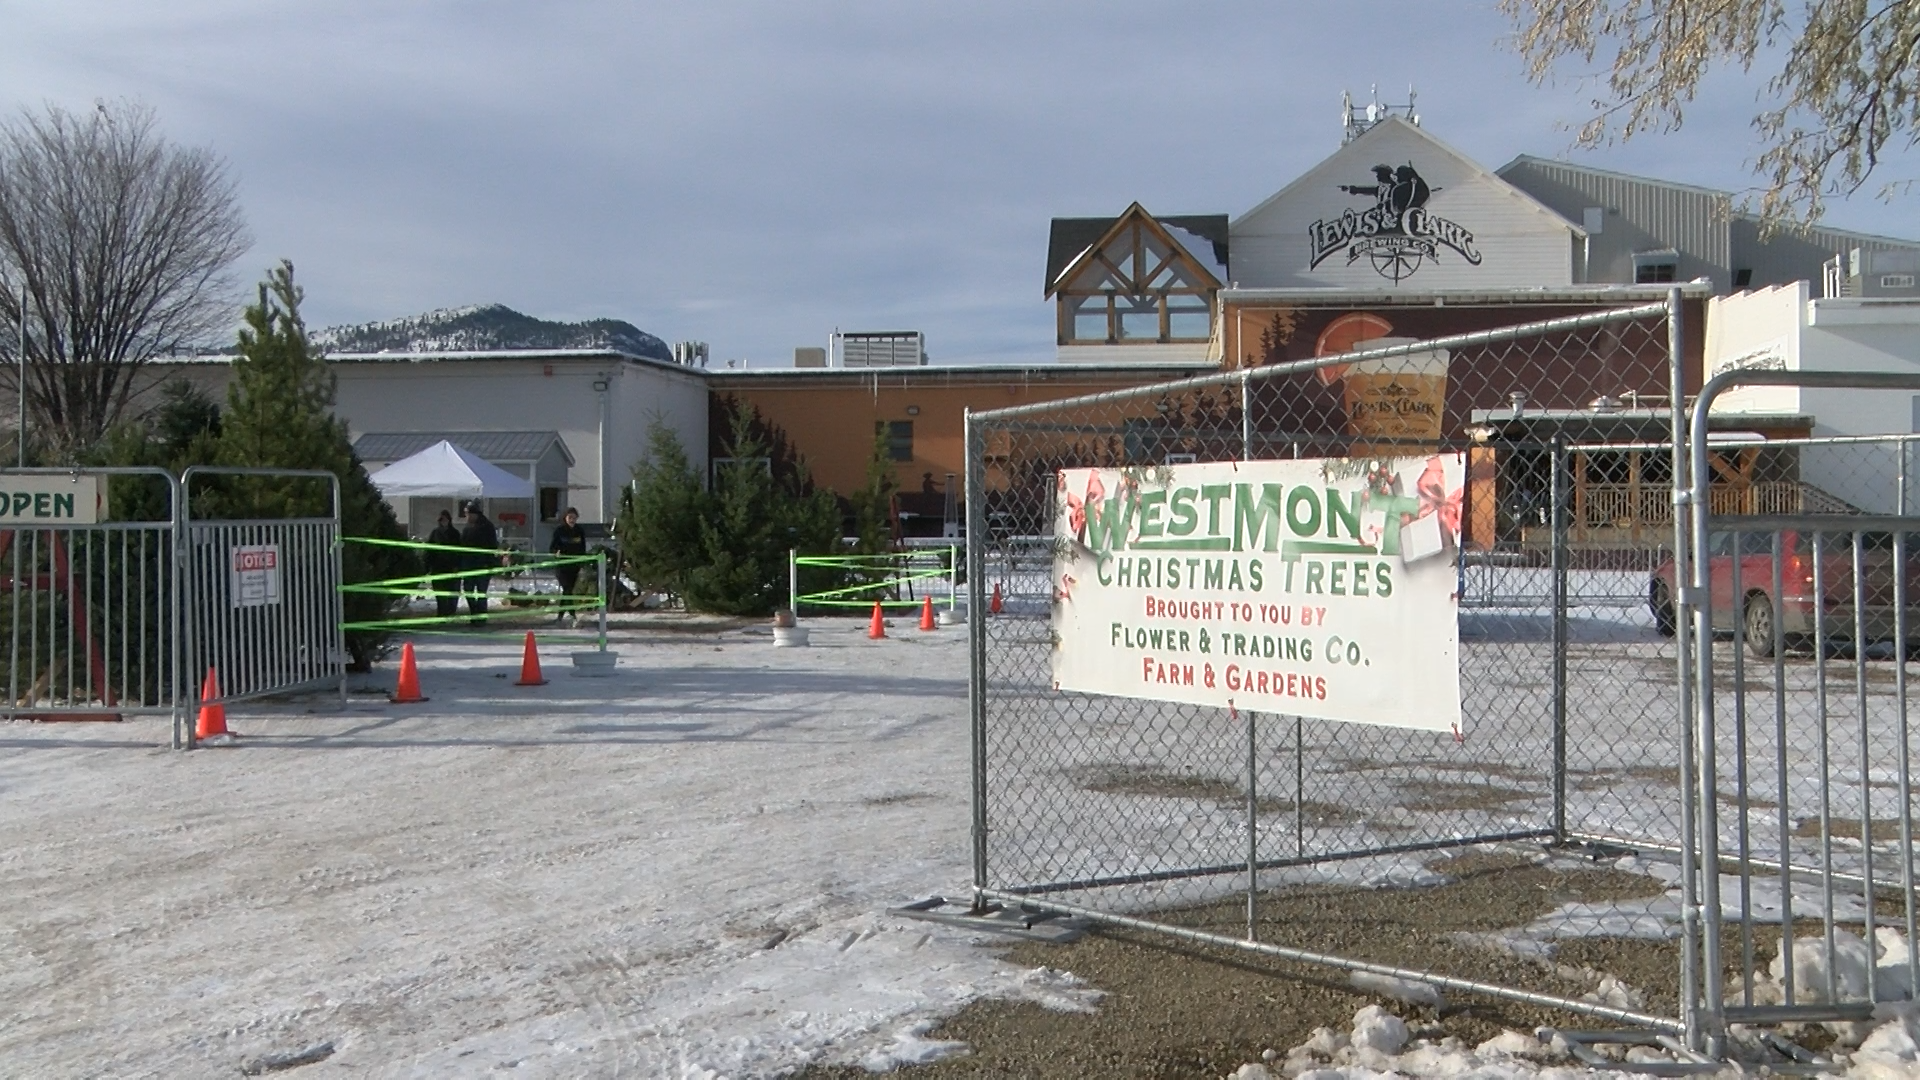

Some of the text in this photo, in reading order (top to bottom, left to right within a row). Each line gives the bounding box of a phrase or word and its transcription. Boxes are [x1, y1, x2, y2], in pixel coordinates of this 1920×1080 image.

[1309, 207, 1482, 271] LEWIS & CLARK
[1084, 482, 1420, 556] WESTMONT
[1097, 540, 1393, 598] CHRISTMAS TREES
[1145, 595, 1326, 627] BROUGHT TO YOU BY
[1111, 622, 1370, 666] FLOWER & TRADING CO.
[1143, 657, 1327, 700] FARM & GARDENS
